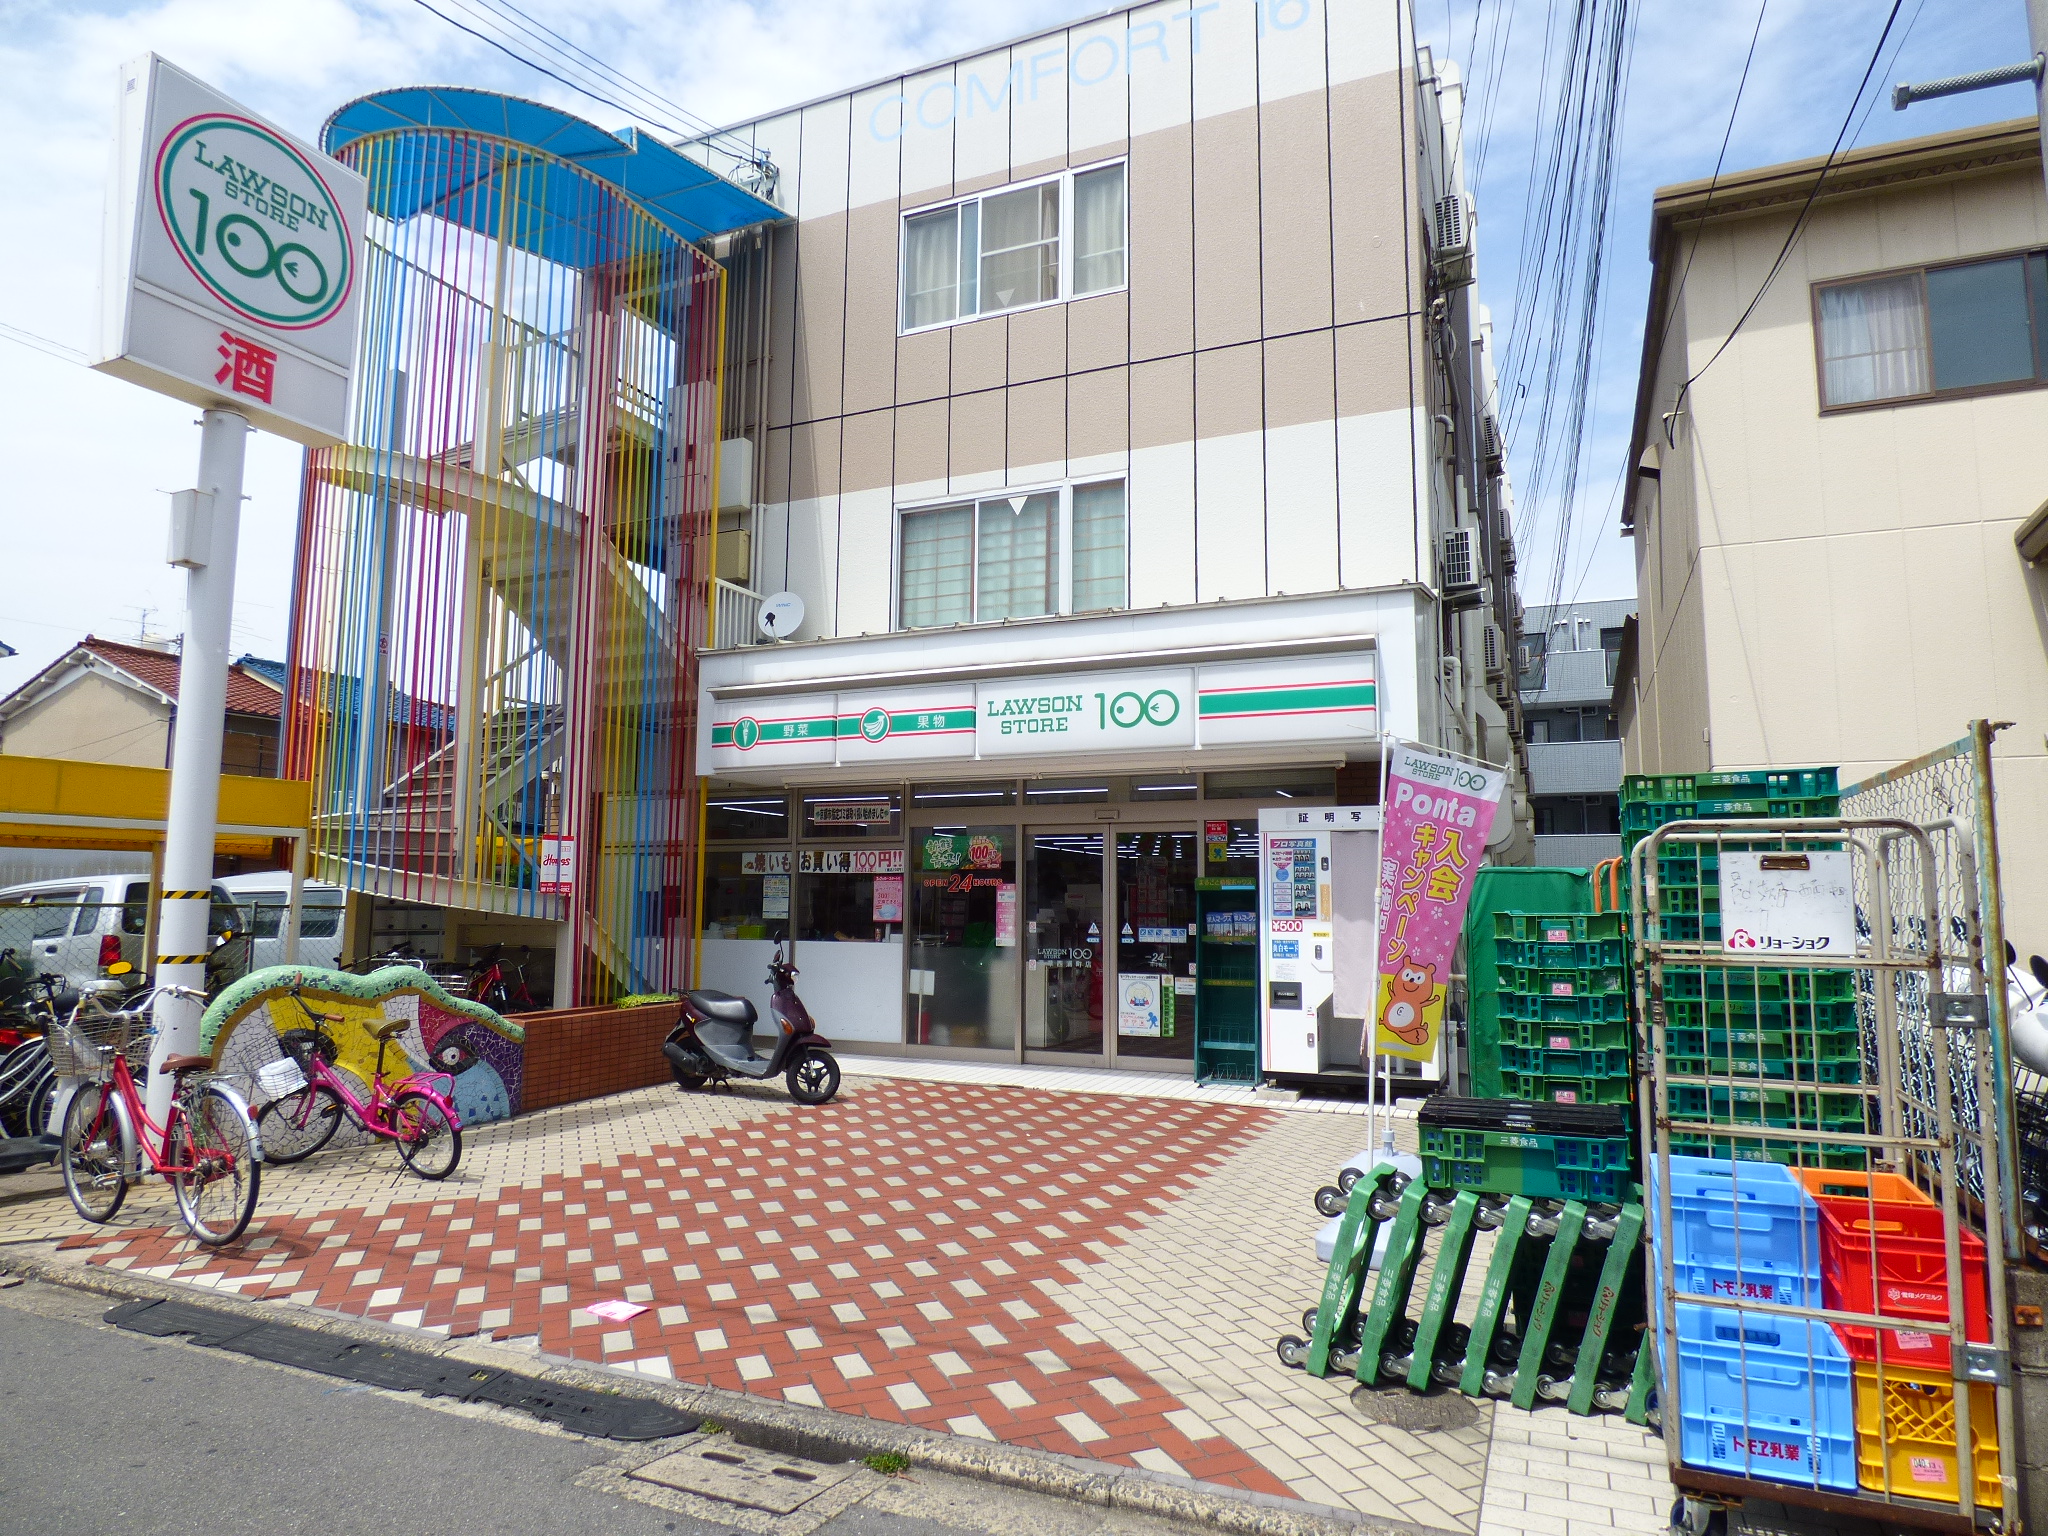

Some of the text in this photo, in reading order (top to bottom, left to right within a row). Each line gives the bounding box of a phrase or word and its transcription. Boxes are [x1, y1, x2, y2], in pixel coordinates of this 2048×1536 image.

[869, 3, 1220, 143] COMFORT
[194, 140, 329, 231] LAWSON
[225, 180, 299, 232] STORE
[189, 187, 329, 304] 100
[215, 331, 278, 405] 酒
[987, 689, 1180, 730] LAWSON 100
[783, 723, 809, 737] 野菜
[917, 715, 945, 729] 果物
[1001, 717, 1068, 735] STORE
[1404, 756, 1487, 791] LAWSON 100
[1412, 769, 1442, 781] STORE
[1712, 774, 1750, 784] 三菱食品
[1394, 782, 1476, 828] Ponta
[1713, 803, 1752, 812] 三菱食品
[1298, 811, 1380, 823] 証明写
[755, 852, 791, 872] 焼いも
[1426, 828, 1468, 904] 入会
[923, 874, 1003, 892] OPEN 24 HOURS
[1387, 824, 1437, 964] キャンペーン
[1272, 920, 1302, 931] ¥500
[1760, 936, 1830, 950] リョーショク
[1068, 947, 1092, 959] 100
[1151, 953, 1165, 963] 24
[1500, 1136, 1538, 1147] 三菱食品
[1901, 1291, 1943, 1300] 雪印メグミルク
